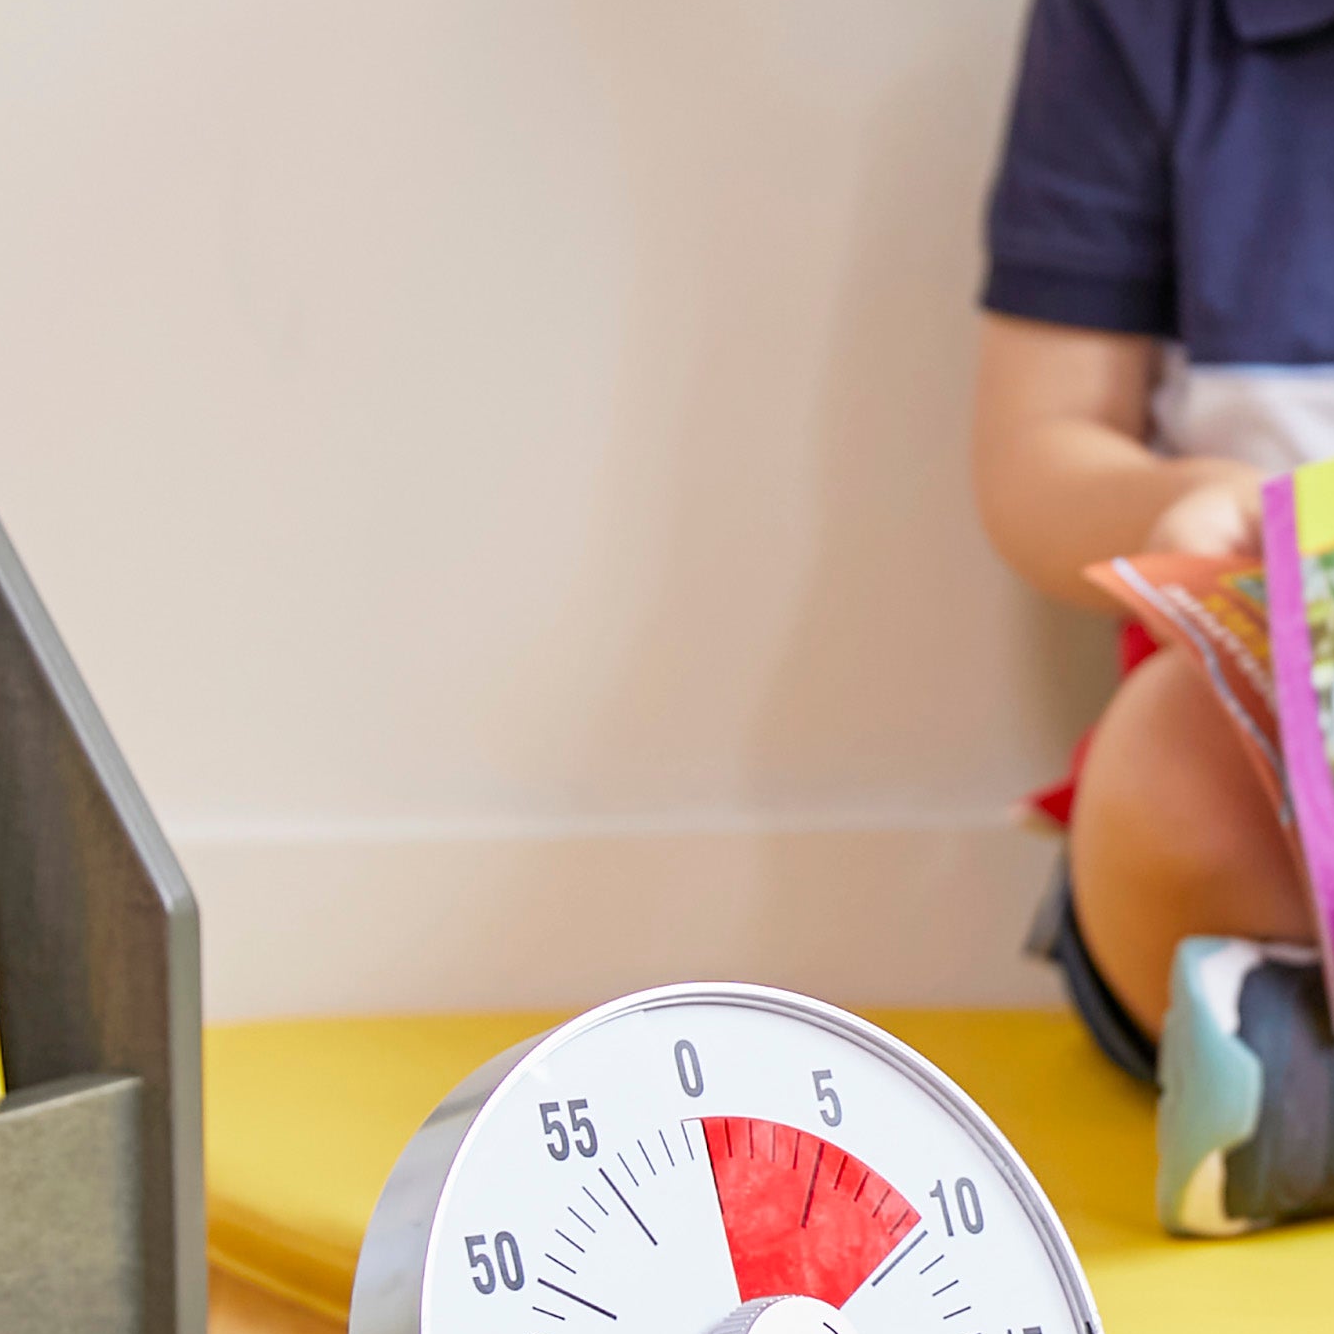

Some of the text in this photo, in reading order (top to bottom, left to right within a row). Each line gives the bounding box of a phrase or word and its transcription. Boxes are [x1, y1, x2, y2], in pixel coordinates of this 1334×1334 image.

[673, 1038, 705, 1099] 0
[813, 1069, 842, 1127] 5
[539, 1098, 598, 1161] 55
[928, 1176, 984, 1237] 10
[464, 1231, 525, 1295] 50
